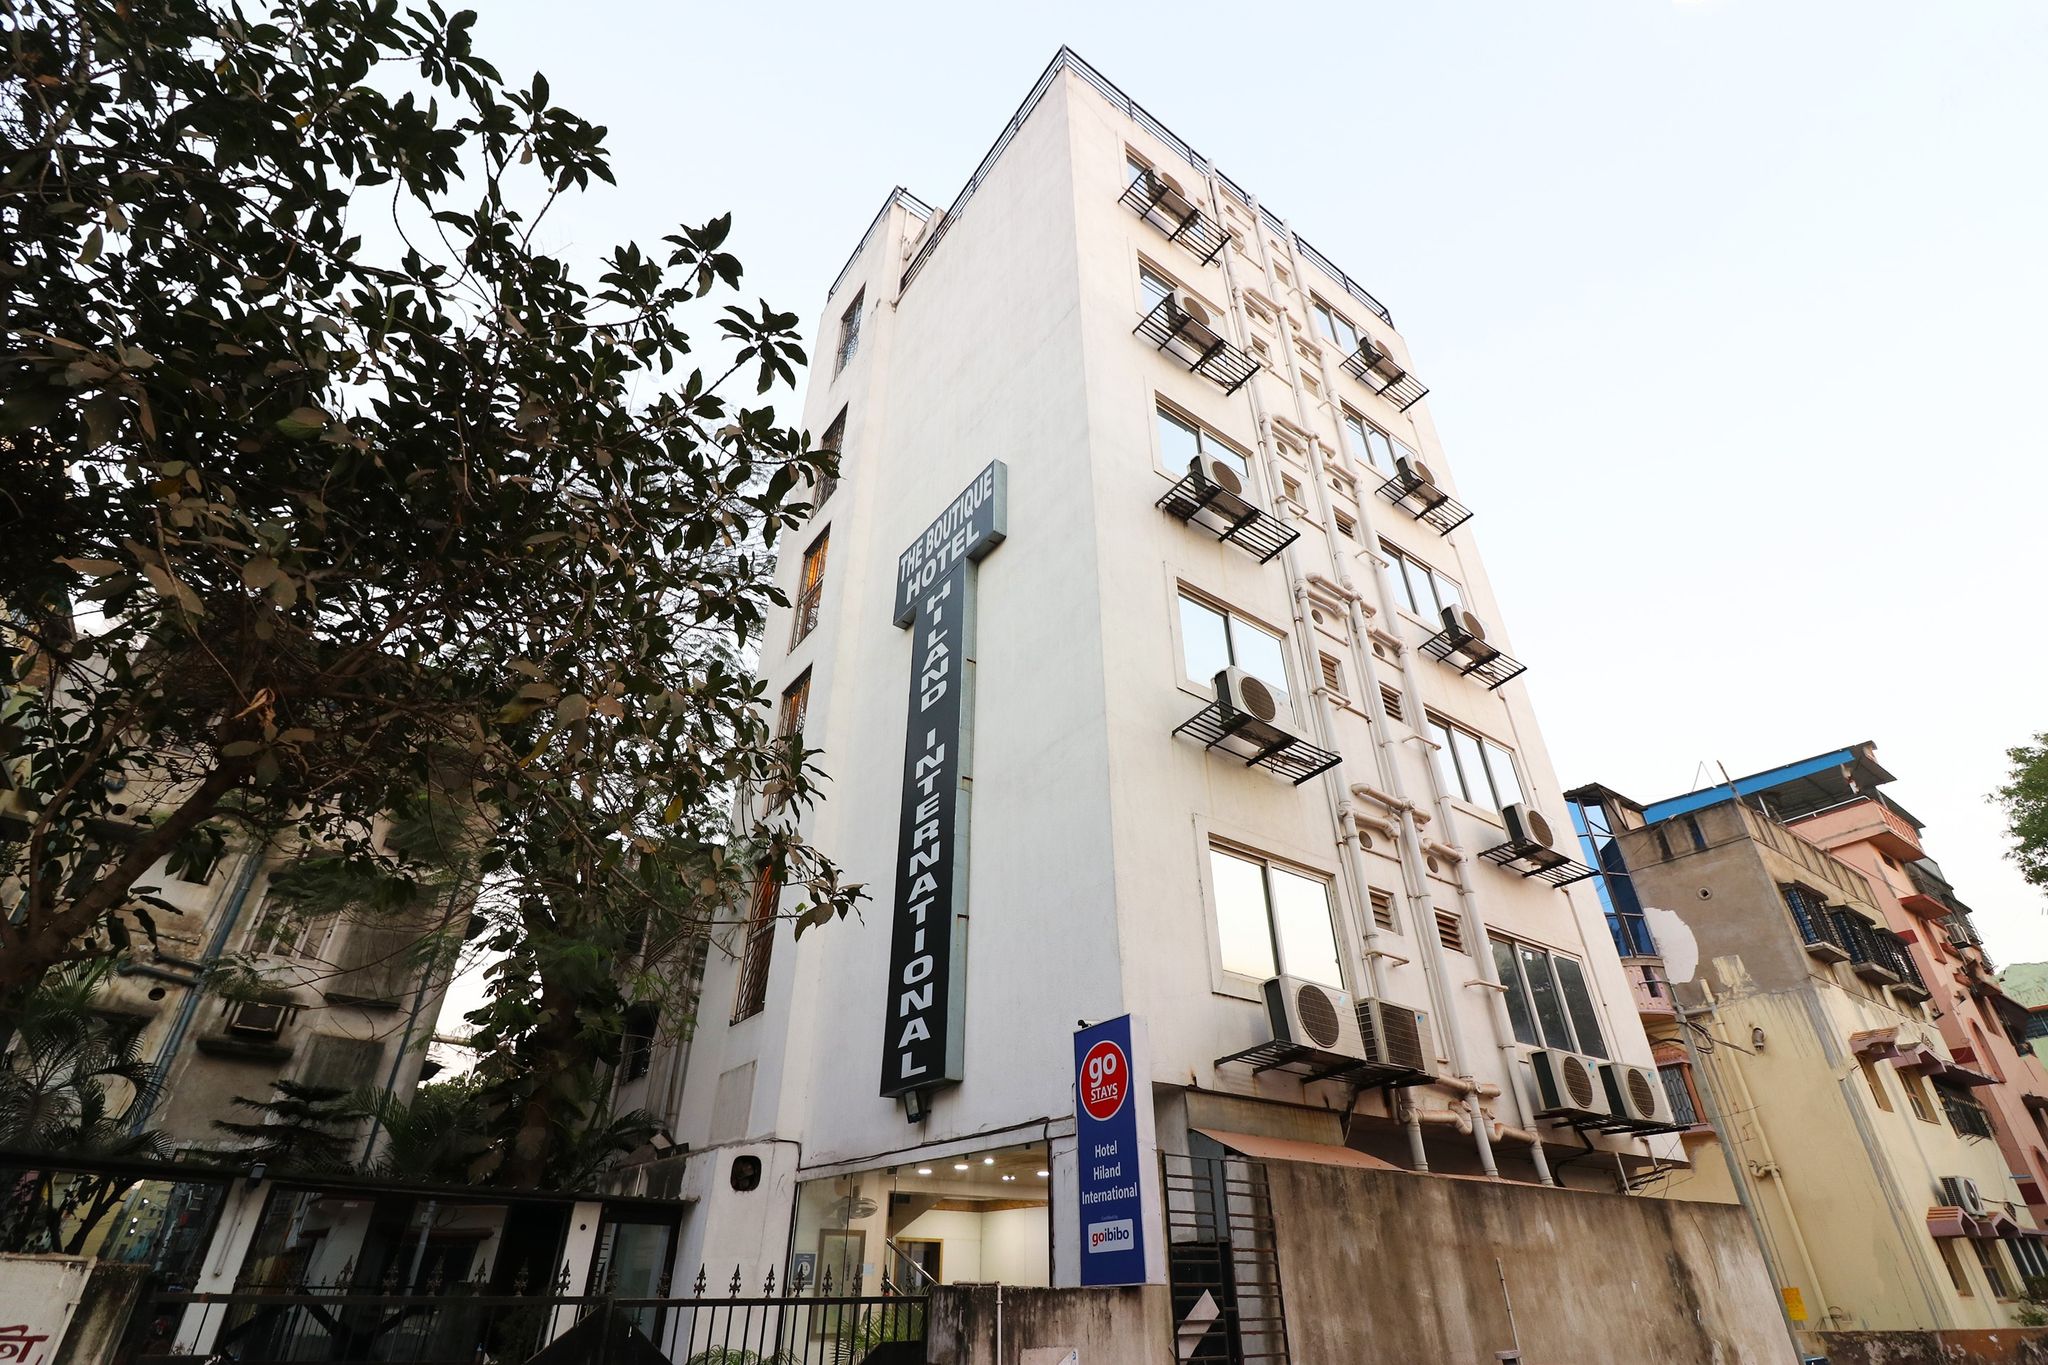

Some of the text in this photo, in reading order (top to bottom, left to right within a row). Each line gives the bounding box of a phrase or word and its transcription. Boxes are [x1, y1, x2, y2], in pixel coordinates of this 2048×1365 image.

[901, 467, 993, 584] THE BOUTIQUE
[905, 521, 980, 605] HOTEL
[898, 579, 952, 1079] HILAND INTERNATIONAL
[1089, 1053, 1117, 1088] go
[1091, 1083, 1118, 1101] STAYS
[1094, 1140, 1118, 1158] Hotel
[1093, 1161, 1121, 1181] Hiland
[1082, 1182, 1138, 1205] International
[1092, 1226, 1130, 1247] goibibo
